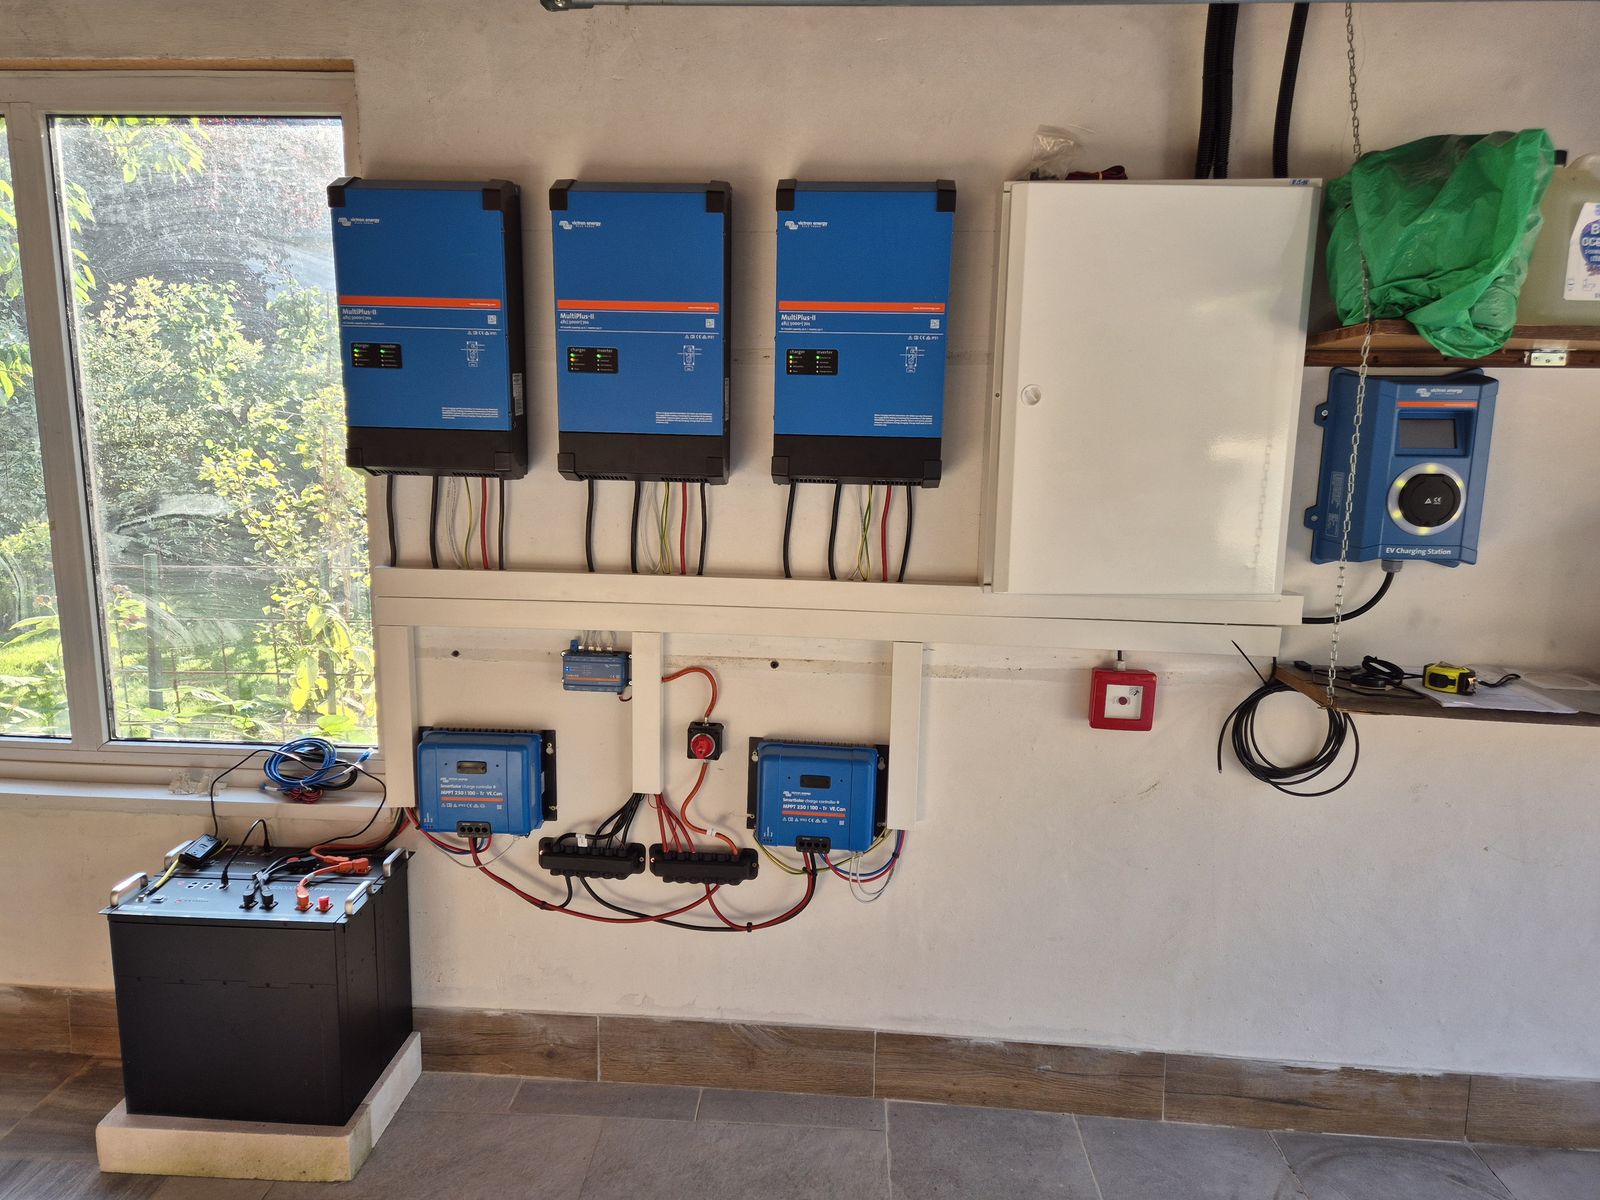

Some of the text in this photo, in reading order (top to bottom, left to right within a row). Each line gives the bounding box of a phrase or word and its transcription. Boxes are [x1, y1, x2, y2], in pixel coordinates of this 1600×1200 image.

[560, 312, 595, 320] MultiPlus-II
[1396, 547, 1427, 557] Charging
[1427, 548, 1452, 556] Station
